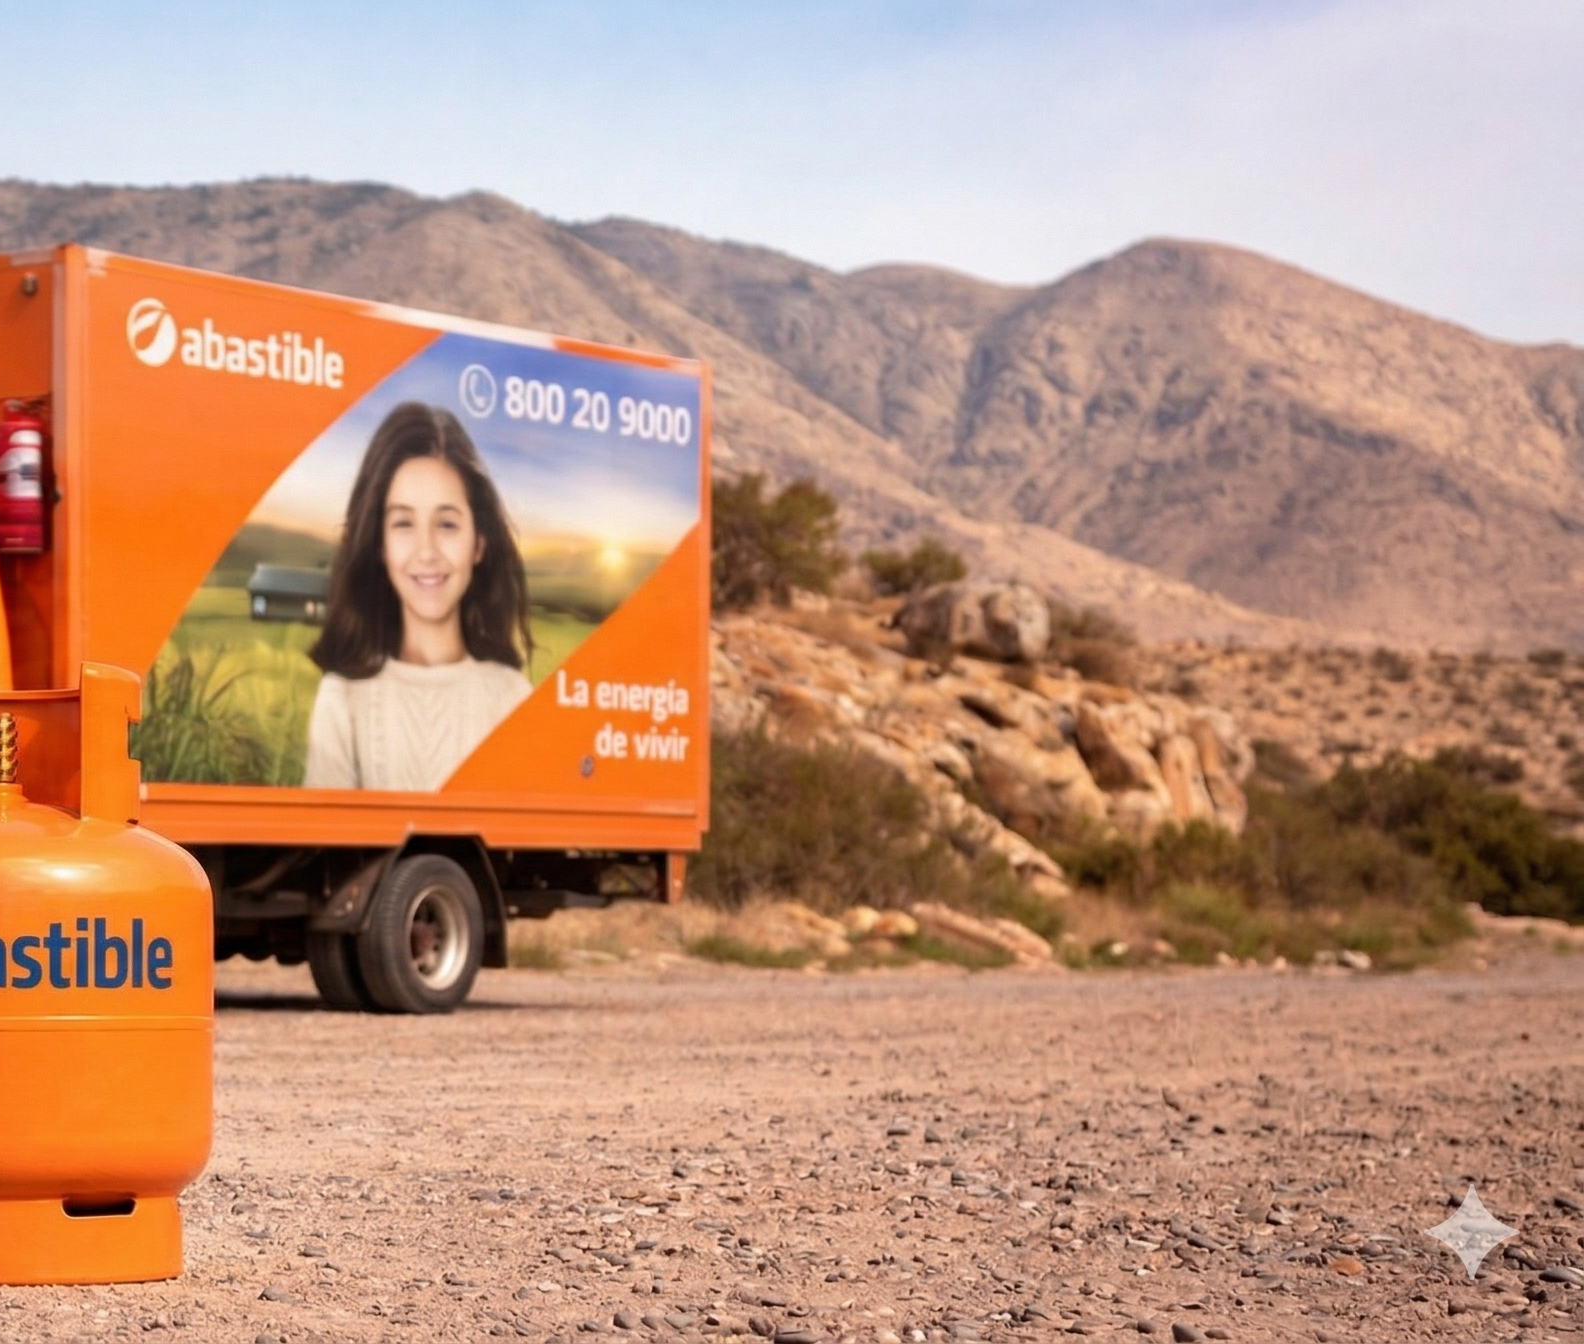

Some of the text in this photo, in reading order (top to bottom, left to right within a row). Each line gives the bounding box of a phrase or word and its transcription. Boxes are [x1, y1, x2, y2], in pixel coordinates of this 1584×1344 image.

[182, 319, 344, 389] abastible
[504, 376, 692, 446] 800 20 9000
[557, 669, 689, 722] La energía
[595, 722, 690, 761] de vivir
